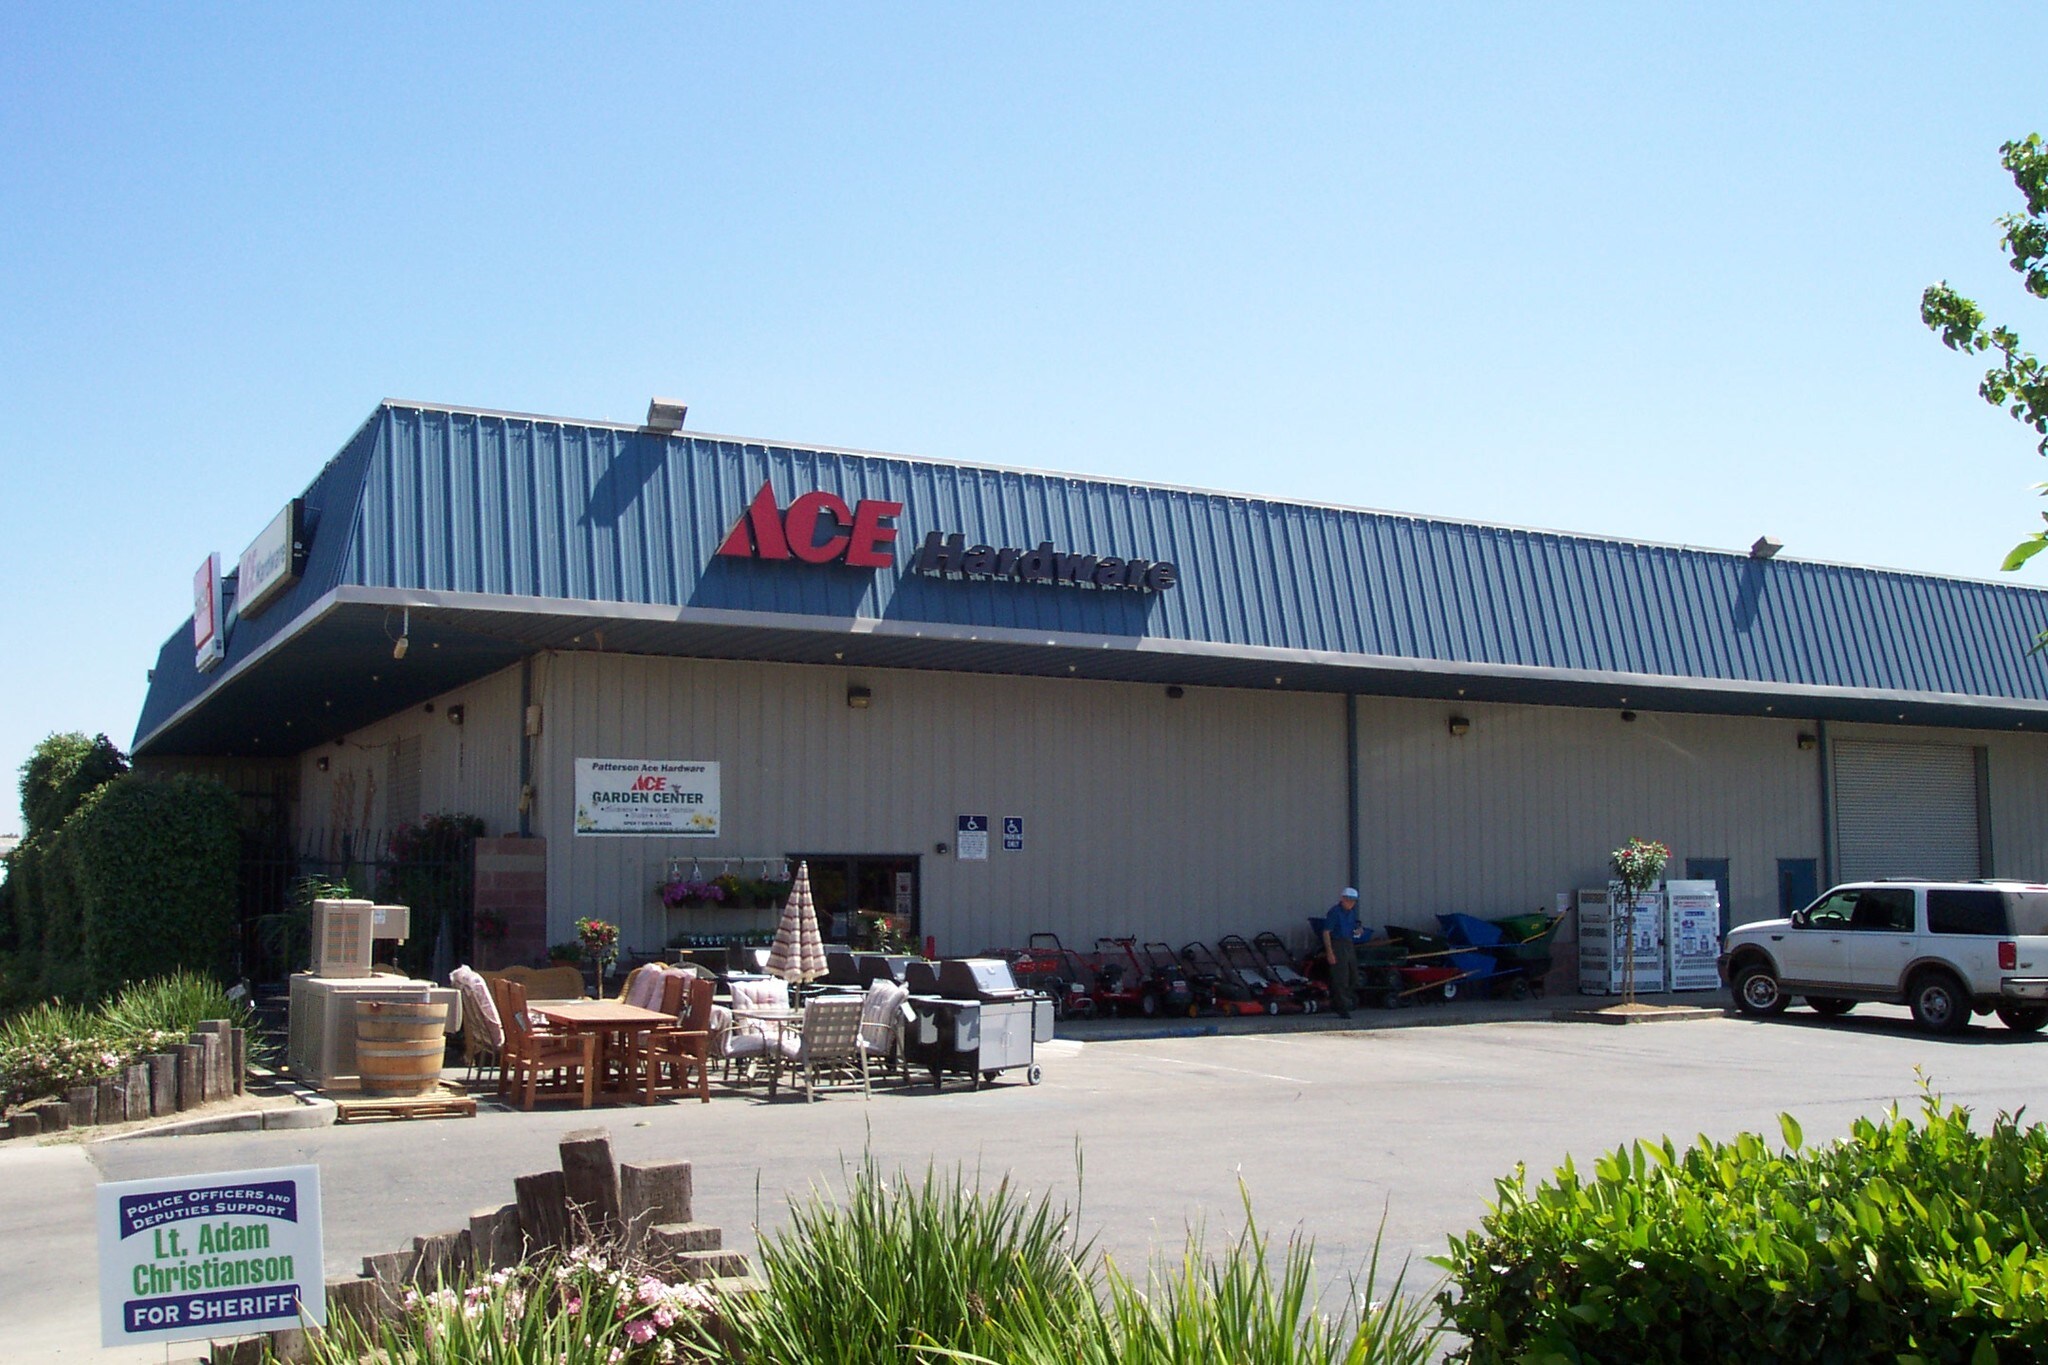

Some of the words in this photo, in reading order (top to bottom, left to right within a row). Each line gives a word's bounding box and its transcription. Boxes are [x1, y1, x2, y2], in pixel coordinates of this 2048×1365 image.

[715, 479, 903, 569] ACE
[914, 530, 1177, 592] Hardware
[592, 762, 639, 772] Patterson
[641, 764, 659, 772] Ace
[661, 764, 706, 773] Hardware
[631, 774, 667, 791] ACE
[592, 791, 650, 804] GARDEN
[652, 792, 704, 804] CENTER
[126, 1195, 184, 1218] POLICE
[188, 1189, 264, 1203] OFFICERS
[266, 1193, 291, 1204] AND
[132, 1205, 210, 1230] DEPUTIES
[215, 1202, 286, 1216] SUPPORT
[154, 1227, 188, 1259] Lt.
[198, 1222, 270, 1255] Adam
[132, 1255, 295, 1296] Christianson
[133, 1305, 180, 1326] FOR
[188, 1293, 293, 1321] SHERIFF
